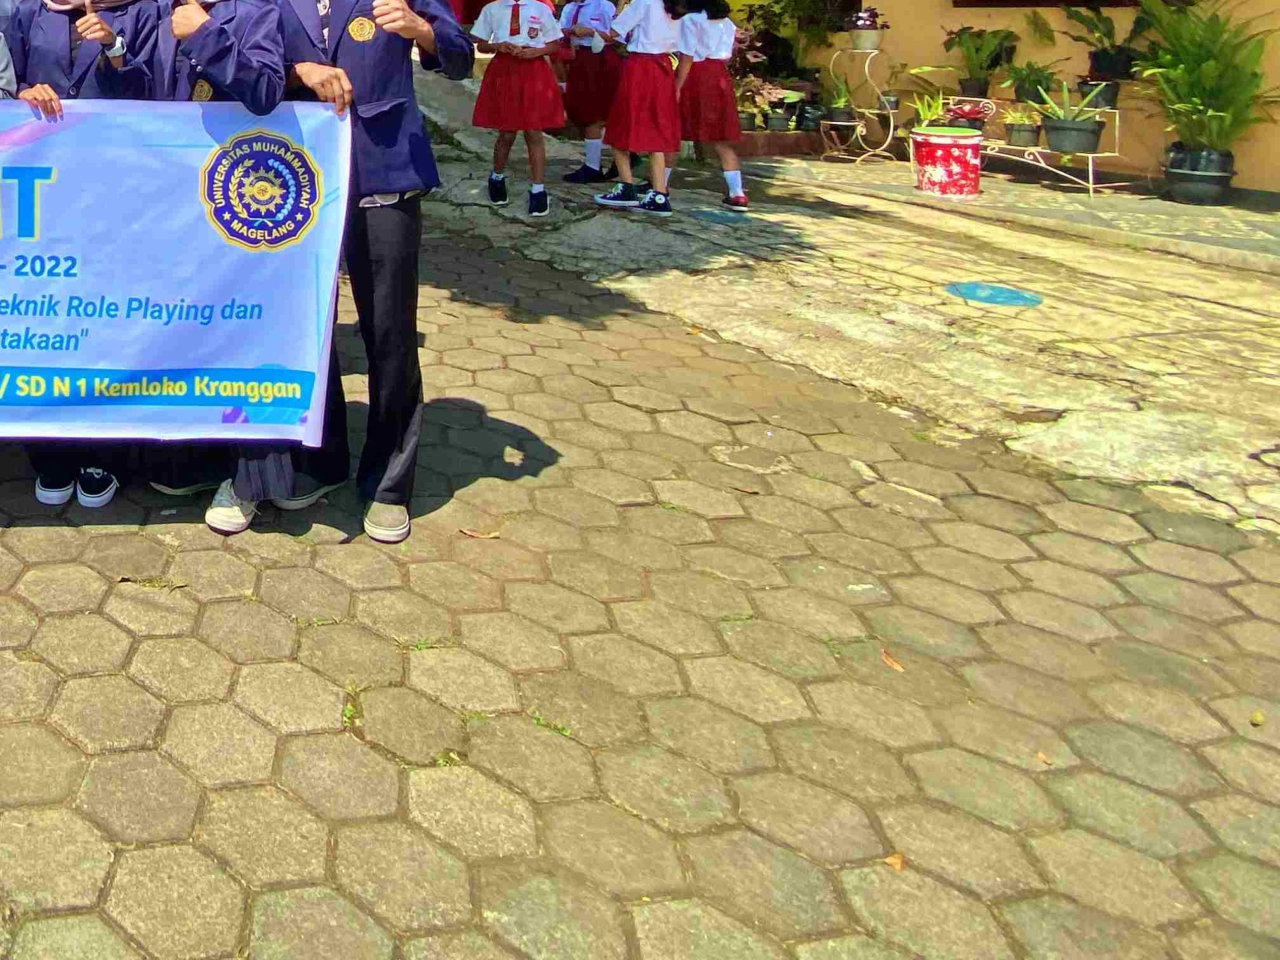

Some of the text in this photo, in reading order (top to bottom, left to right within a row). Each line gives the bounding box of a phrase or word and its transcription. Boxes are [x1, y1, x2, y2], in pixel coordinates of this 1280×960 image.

[213, 142, 311, 209] UNIVERSITAS MUHAMMADIYAH
[230, 219, 296, 240] MAGELANG
[14, 255, 78, 278] 2022
[66, 296, 120, 319] Role
[125, 297, 215, 326] Playing
[221, 298, 263, 320] dan
[15, 375, 47, 397] SD
[53, 375, 72, 397] N
[76, 375, 87, 397] 1
[94, 375, 188, 398] Kemloko
[194, 376, 302, 403] Kranggan
